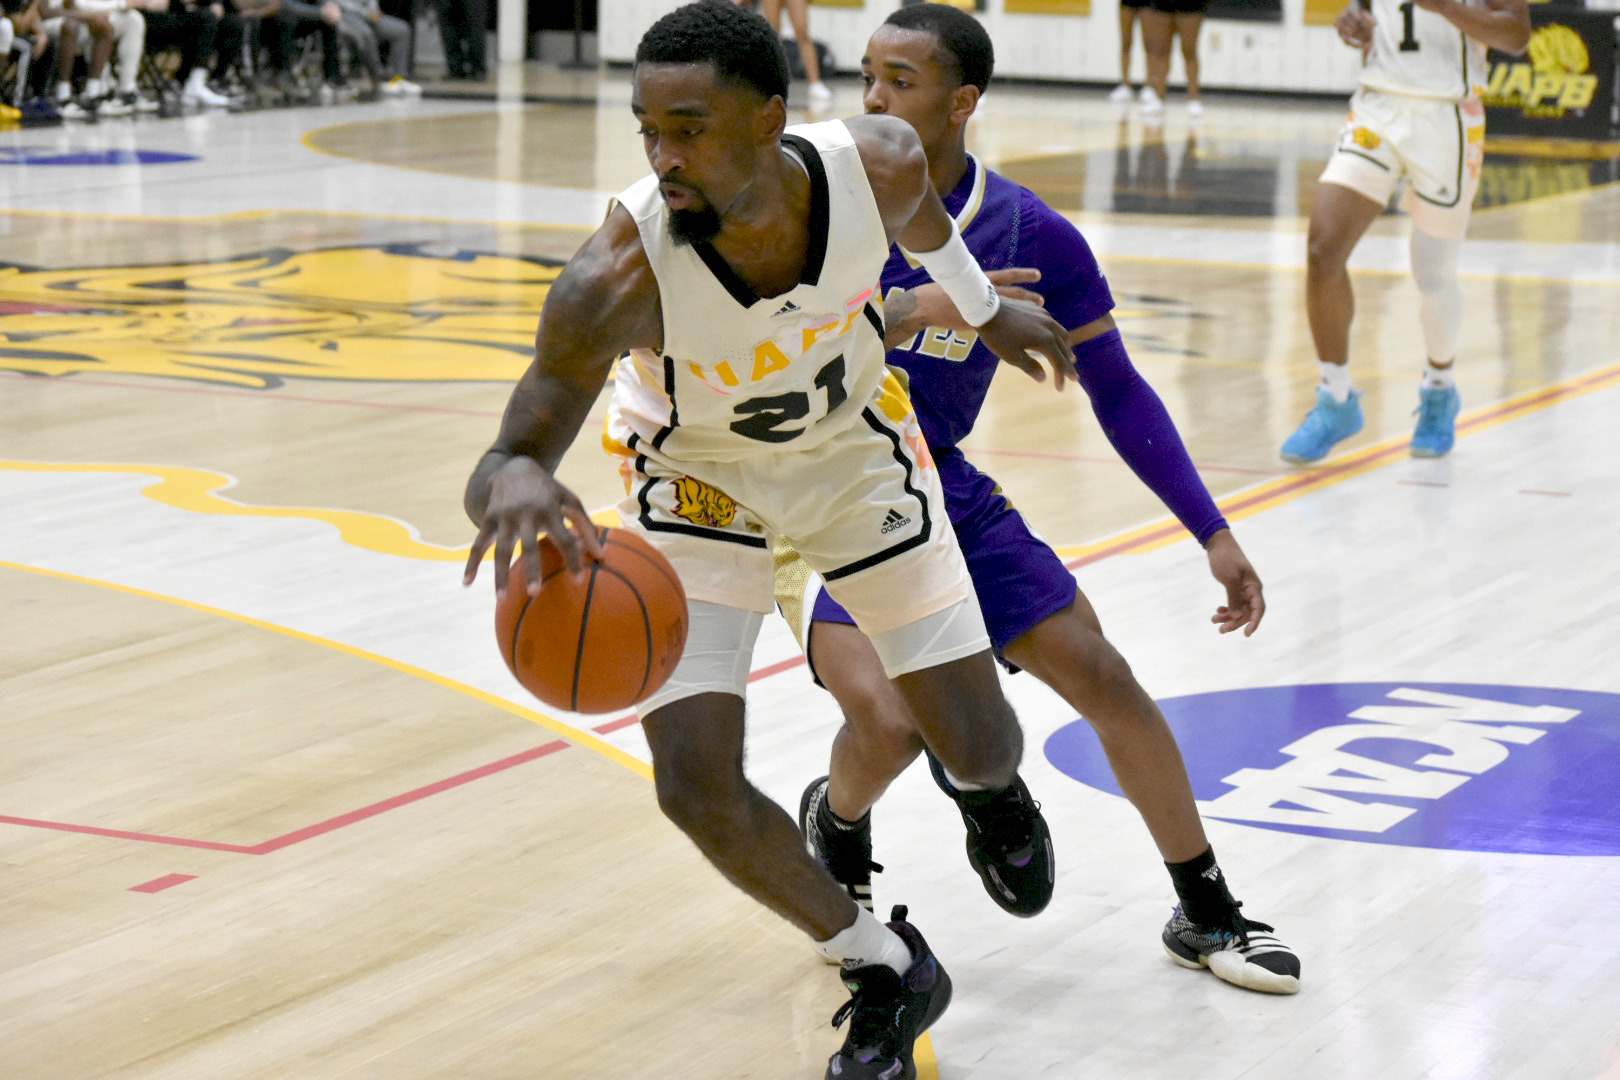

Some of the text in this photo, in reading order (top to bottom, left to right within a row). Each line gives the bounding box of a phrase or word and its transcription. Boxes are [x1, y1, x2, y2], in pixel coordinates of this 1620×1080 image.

[1399, 1, 1420, 51] 1
[729, 353, 848, 443] 21
[880, 516, 912, 535] adidas
[1200, 687, 1582, 833] NCAA
